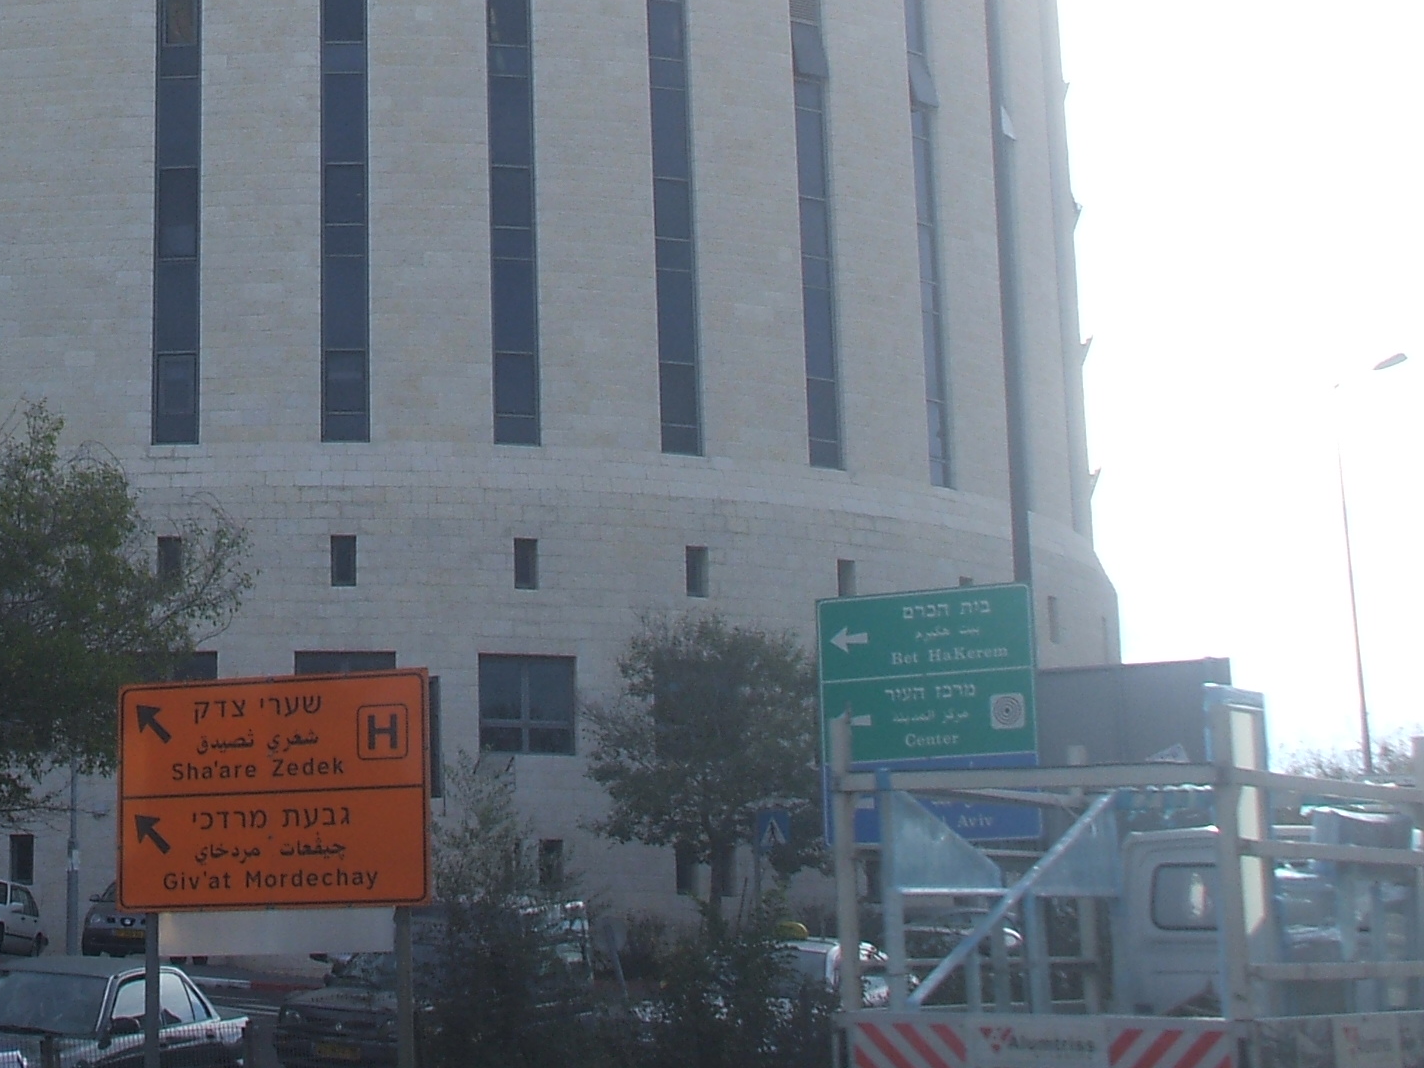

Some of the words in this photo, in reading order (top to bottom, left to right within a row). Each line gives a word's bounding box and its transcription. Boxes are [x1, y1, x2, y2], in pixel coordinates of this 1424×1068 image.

[902, 603, 950, 619] הכרם
[960, 599, 991, 615] בית
[891, 651, 919, 665] Bet
[928, 645, 1008, 662] HaKerem
[884, 686, 925, 701] העיר
[935, 683, 975, 699] מרכז
[193, 698, 245, 725] צדק
[260, 694, 322, 716] שערי
[367, 713, 398, 750] H
[905, 732, 959, 747] Center
[172, 760, 257, 781] Sha'are
[272, 756, 345, 778] Zedek
[192, 809, 267, 830] מרדכי
[281, 806, 351, 829] גבעת
[957, 814, 993, 828] Aviv
[163, 871, 232, 892] Giv'at
[245, 868, 379, 892] Mordechay
